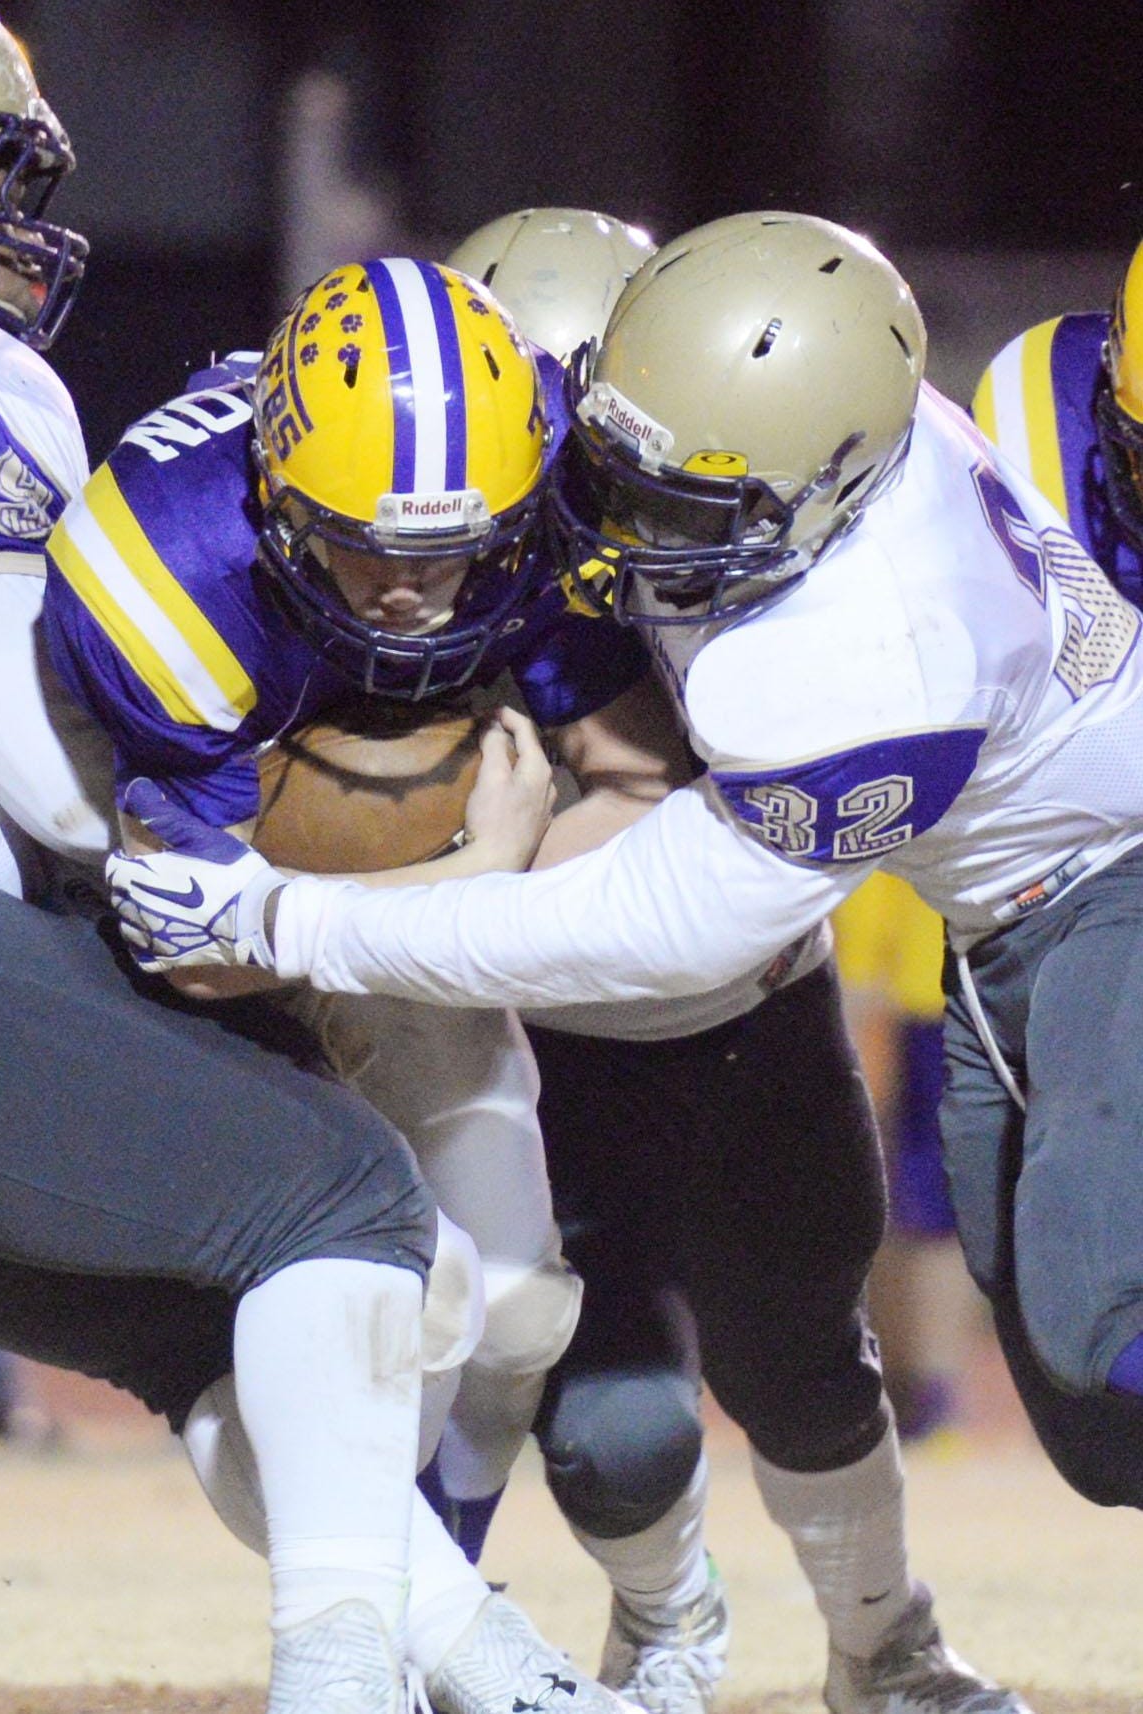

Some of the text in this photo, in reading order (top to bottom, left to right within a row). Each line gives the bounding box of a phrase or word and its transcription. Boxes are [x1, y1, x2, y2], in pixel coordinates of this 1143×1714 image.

[608, 398, 652, 441] Riddell
[402, 498, 462, 516] Riddell
[744, 774, 914, 860] 32
